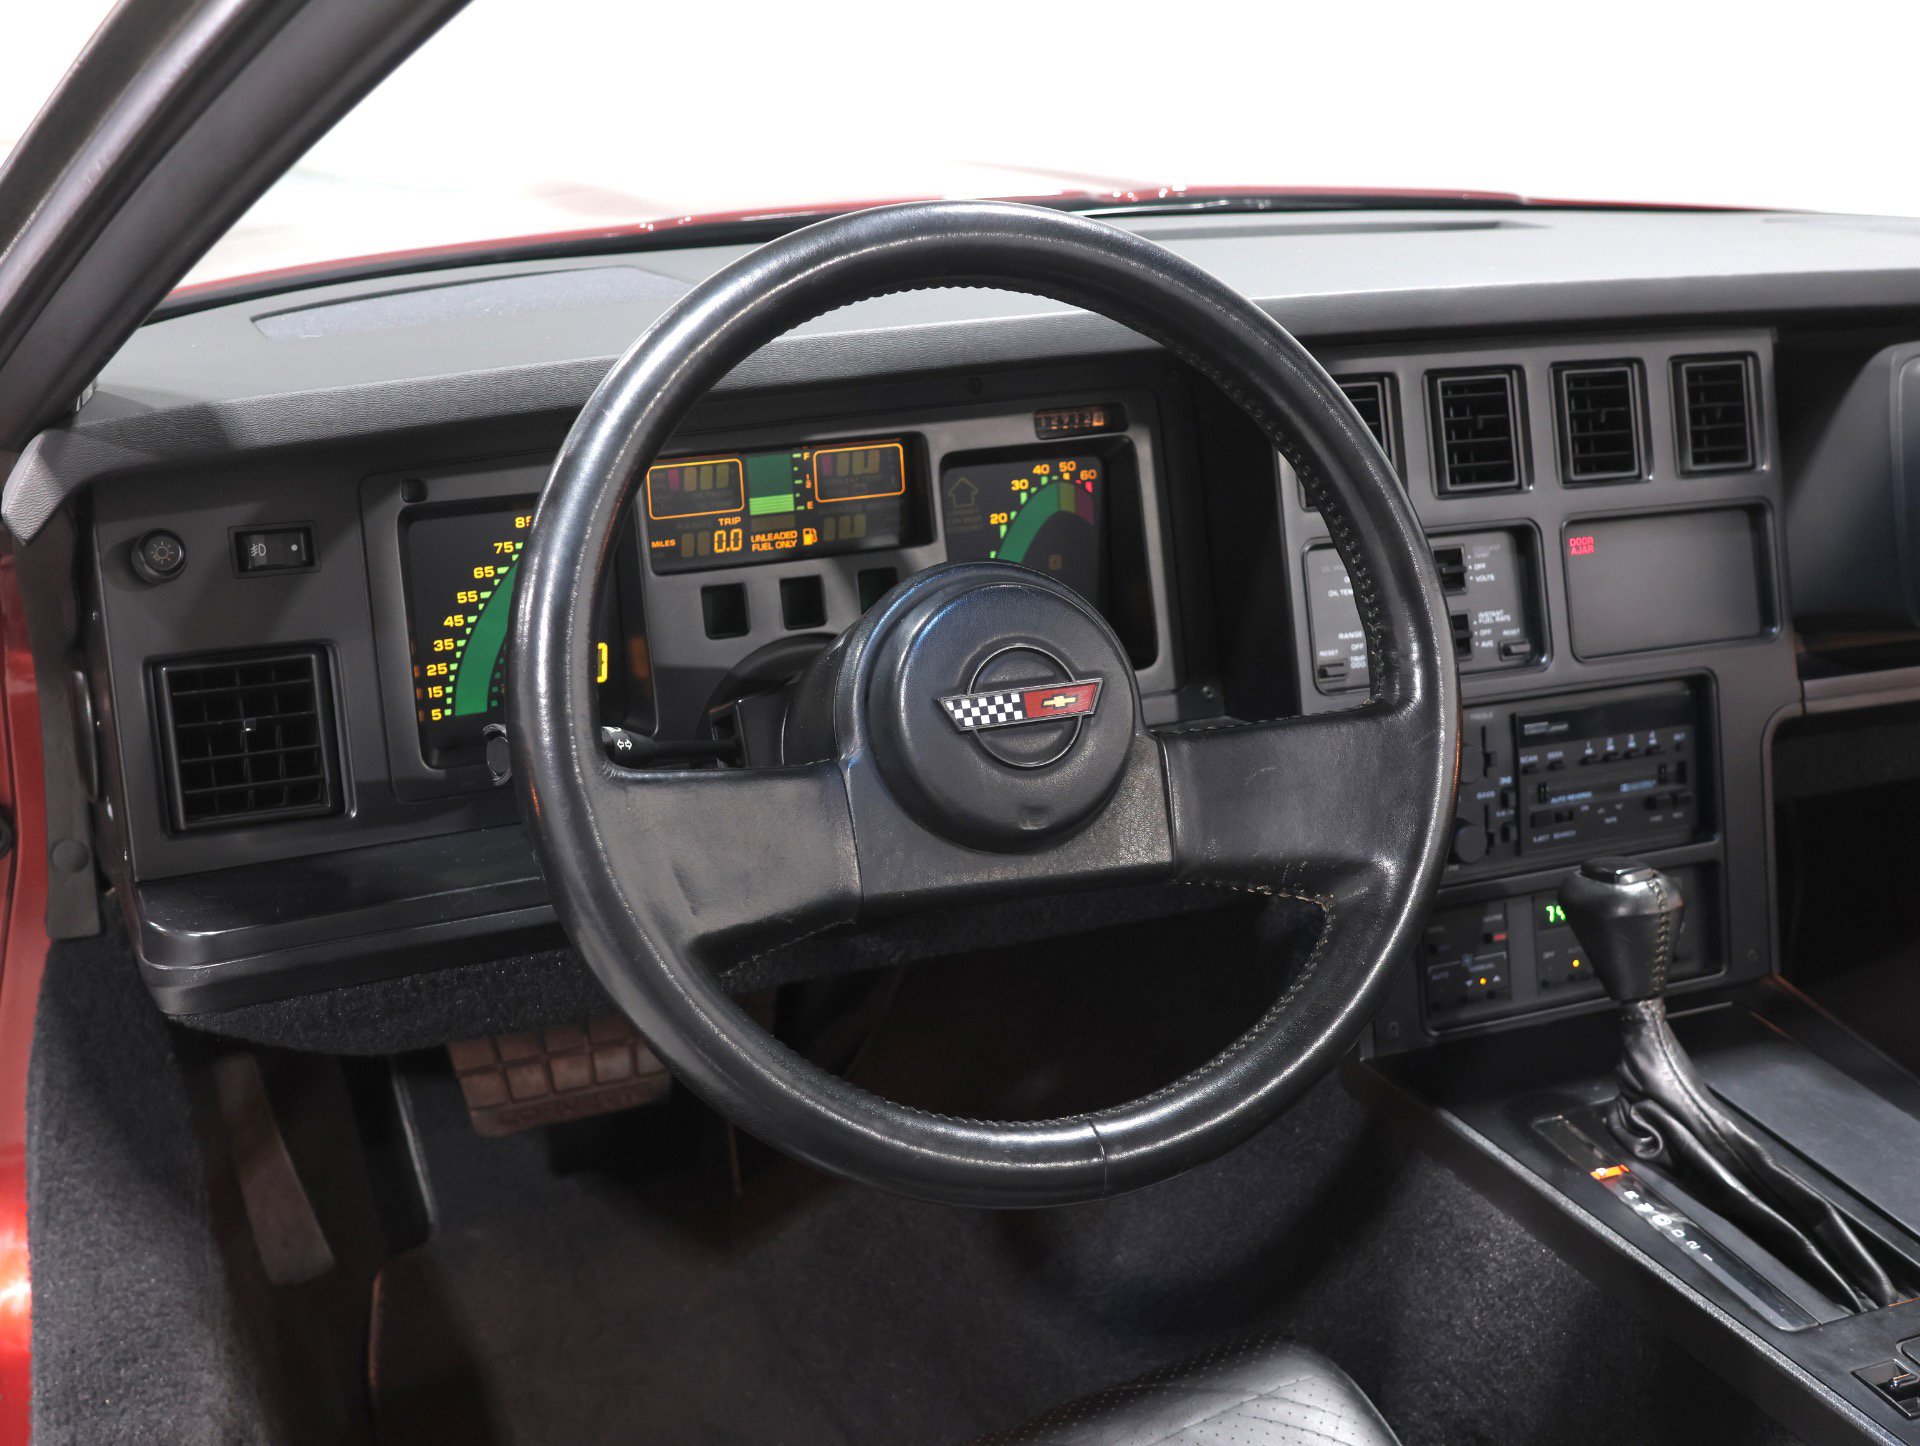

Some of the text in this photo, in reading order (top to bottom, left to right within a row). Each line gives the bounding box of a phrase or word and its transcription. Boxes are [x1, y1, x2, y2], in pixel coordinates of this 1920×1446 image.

[803, 452, 811, 461] F
[1032, 464, 1051, 475] 40
[1058, 461, 1077, 472] 50
[1079, 469, 1098, 480] 60
[1011, 479, 1030, 491] 30
[806, 501, 814, 510] E
[718, 516, 742, 526] TRIP
[989, 513, 1009, 525] 20
[713, 528, 743, 553] 0.0
[750, 530, 798, 543] UNLEADED
[1568, 536, 1595, 547] DOOR
[493, 542, 514, 554] 75
[651, 539, 676, 548] MILES
[751, 539, 798, 552] FUEL ONLY
[1570, 545, 1595, 556] AJAR
[473, 566, 495, 578] 65
[1475, 574, 1495, 582] VOLTS
[456, 591, 478, 604] 55
[1340, 588, 1354, 597] TEM
[443, 615, 465, 628] 45
[1338, 630, 1363, 640] RANGE
[433, 639, 455, 651] 35
[426, 663, 448, 676] 25
[427, 686, 444, 698] 15
[431, 709, 442, 721] 5
